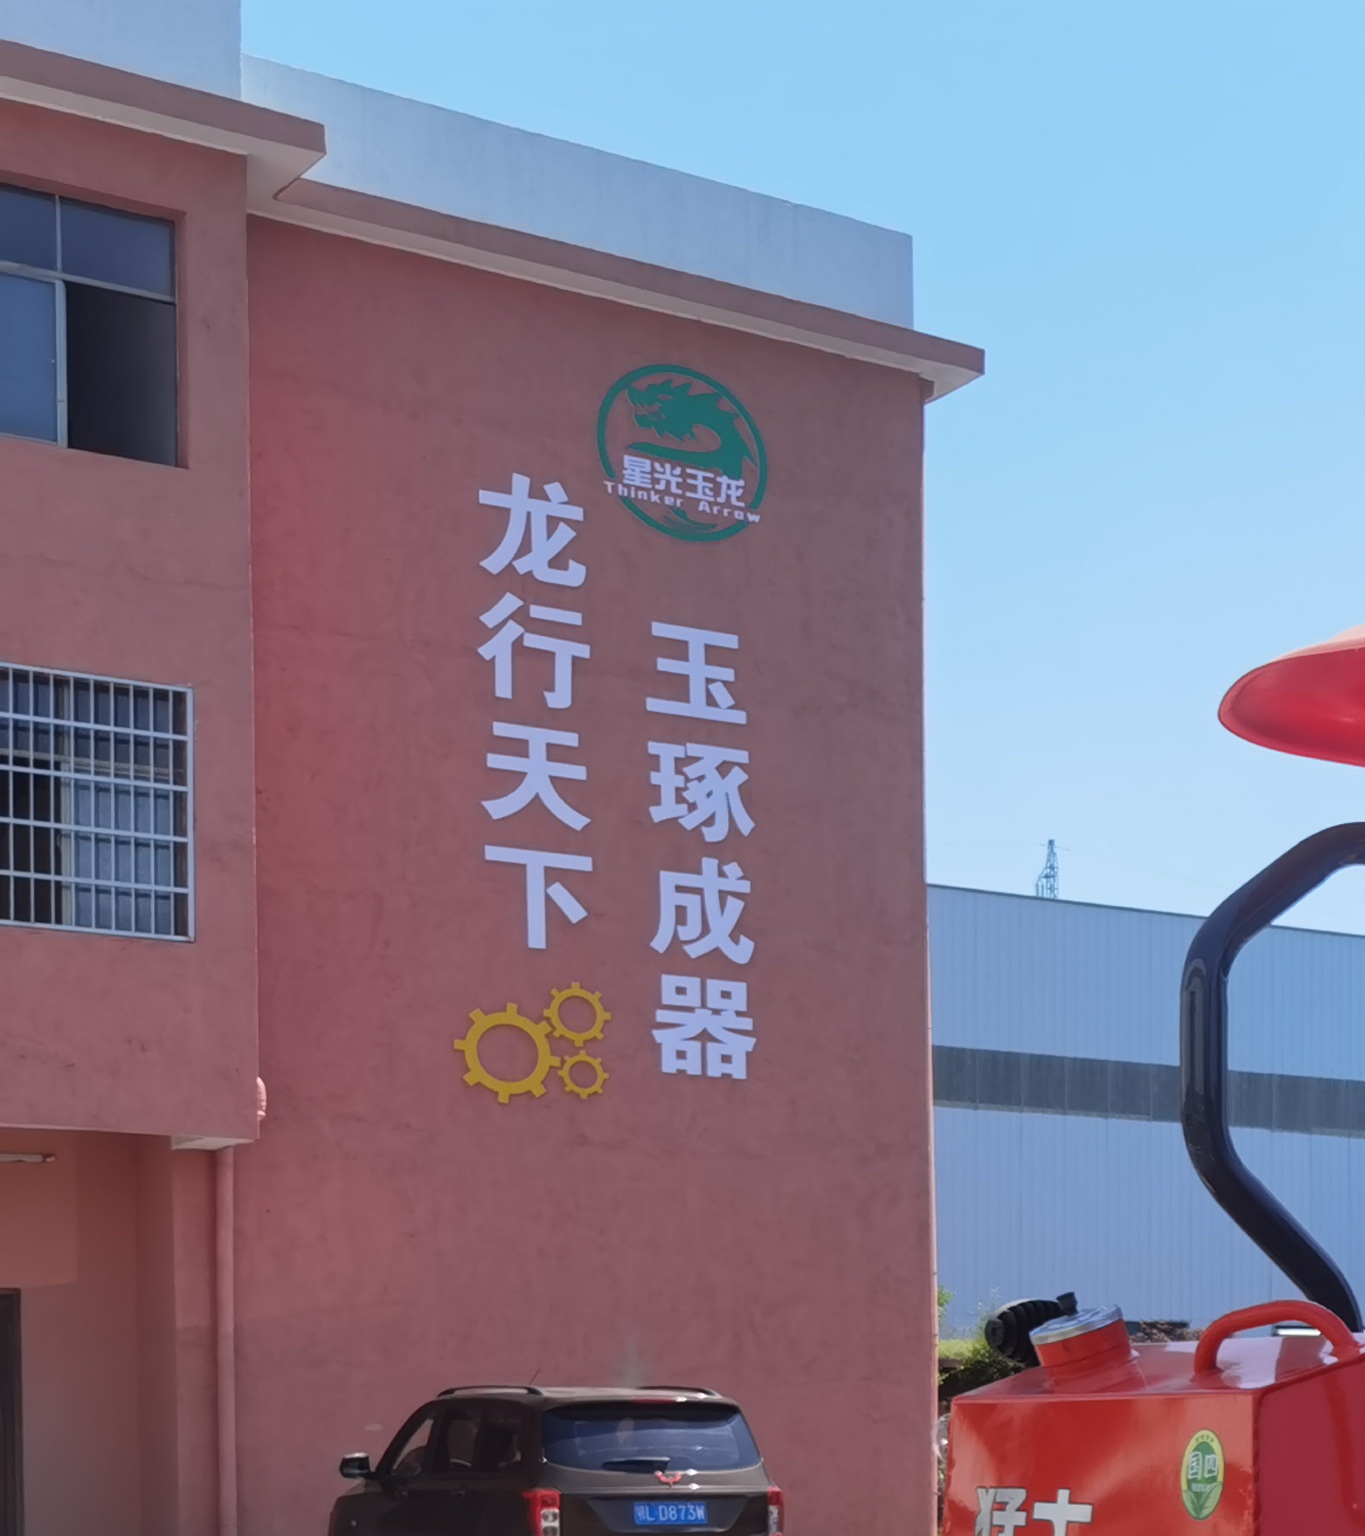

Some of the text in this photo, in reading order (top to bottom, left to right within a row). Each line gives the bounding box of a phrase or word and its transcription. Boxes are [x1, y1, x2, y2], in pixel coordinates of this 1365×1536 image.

[603, 480, 761, 524] Thinker Arrow
[622, 454, 746, 508] 星光玉龙
[476, 472, 594, 950] 龙行天下
[645, 621, 758, 1081] 玉琢成器
